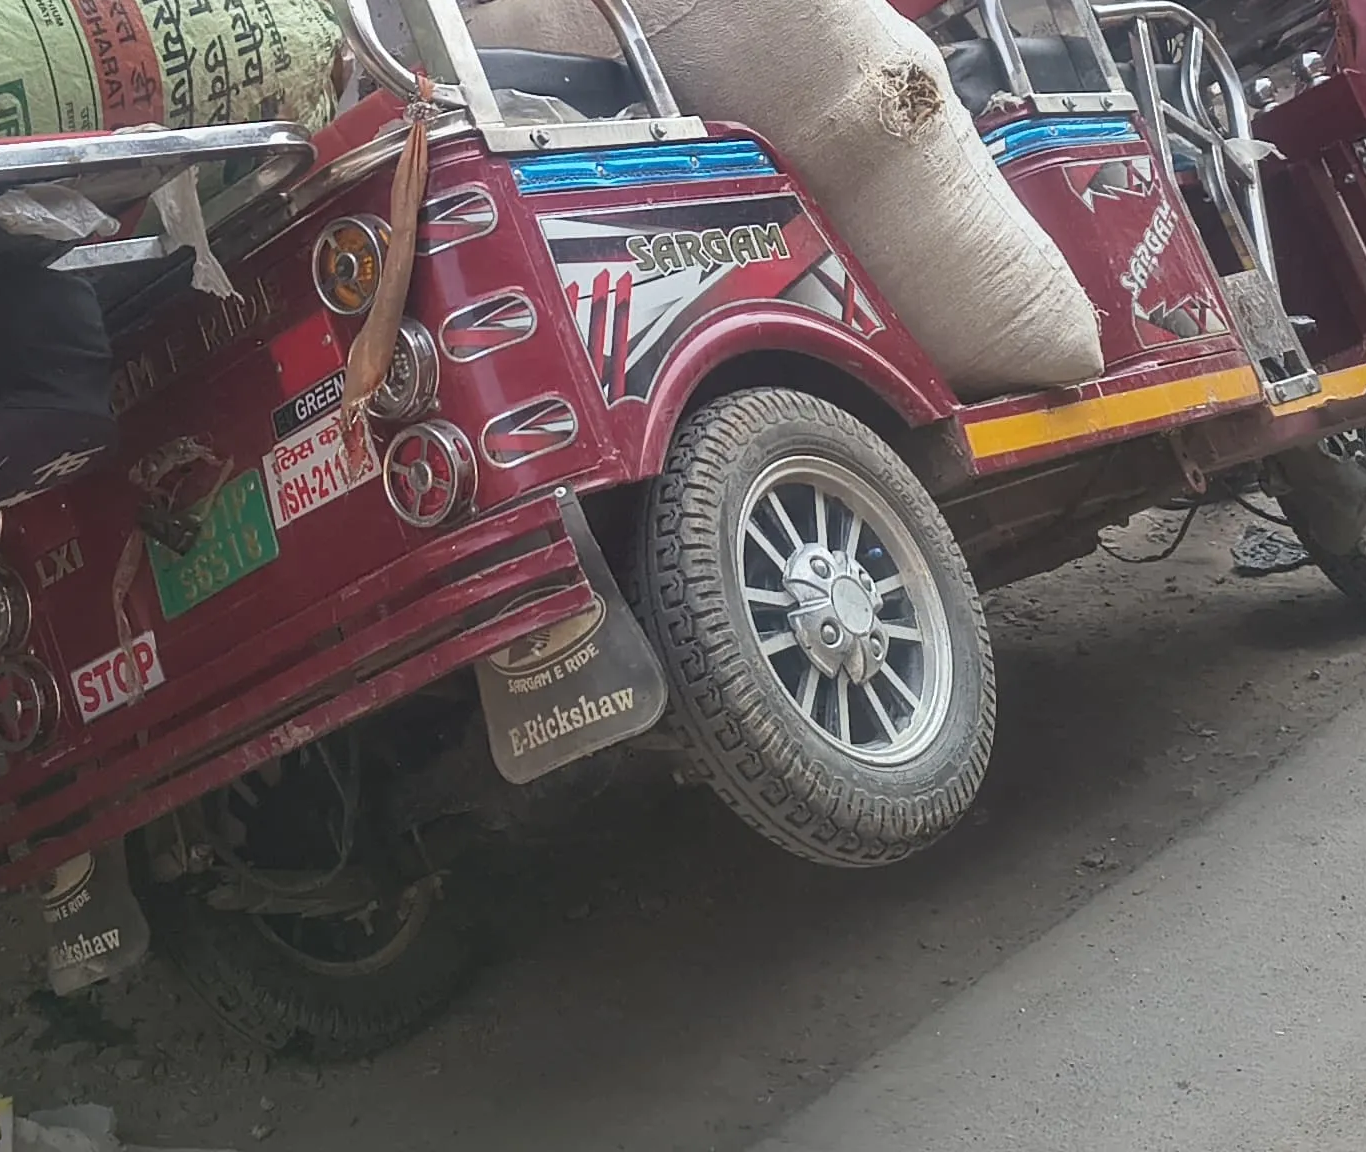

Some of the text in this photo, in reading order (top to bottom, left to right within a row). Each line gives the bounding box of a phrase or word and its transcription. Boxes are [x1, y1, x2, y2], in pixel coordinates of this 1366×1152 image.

[204, 34, 241, 125] उर्वर
[625, 222, 790, 276] SARGAM
[294, 373, 345, 422] GREEN
[35, 538, 85, 589] LXI
[77, 641, 155, 714] STOP
[507, 642, 601, 696] SARGAM E RIDE
[508, 687, 635, 758] E-Rickshaw
